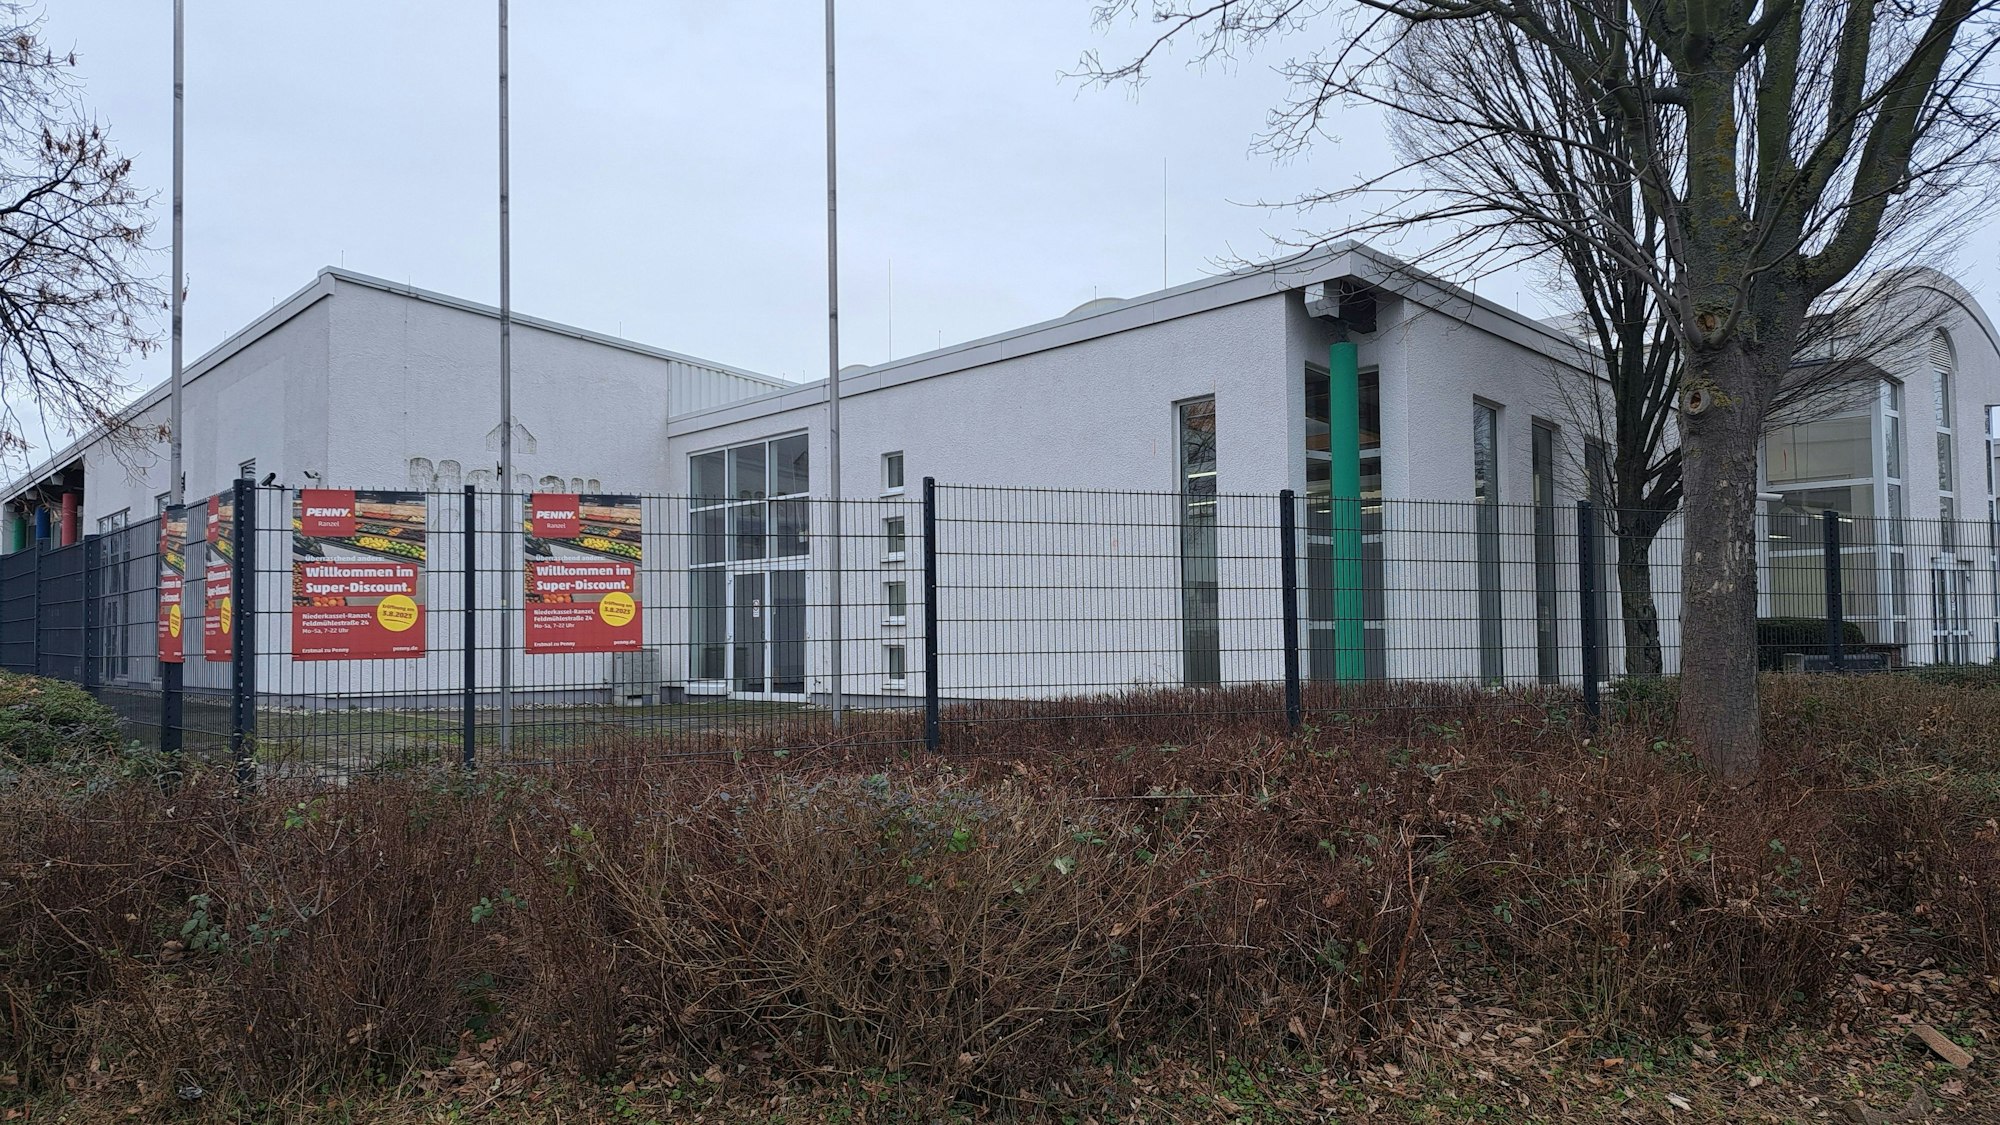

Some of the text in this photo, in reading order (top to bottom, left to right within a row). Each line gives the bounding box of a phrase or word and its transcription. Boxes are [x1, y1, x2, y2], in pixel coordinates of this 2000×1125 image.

[306, 566, 414, 577] Willkommen im
[536, 564, 631, 576] Willkommen im
[306, 581, 412, 595] Super-Discount.
[536, 579, 630, 592] Super-Discount.
